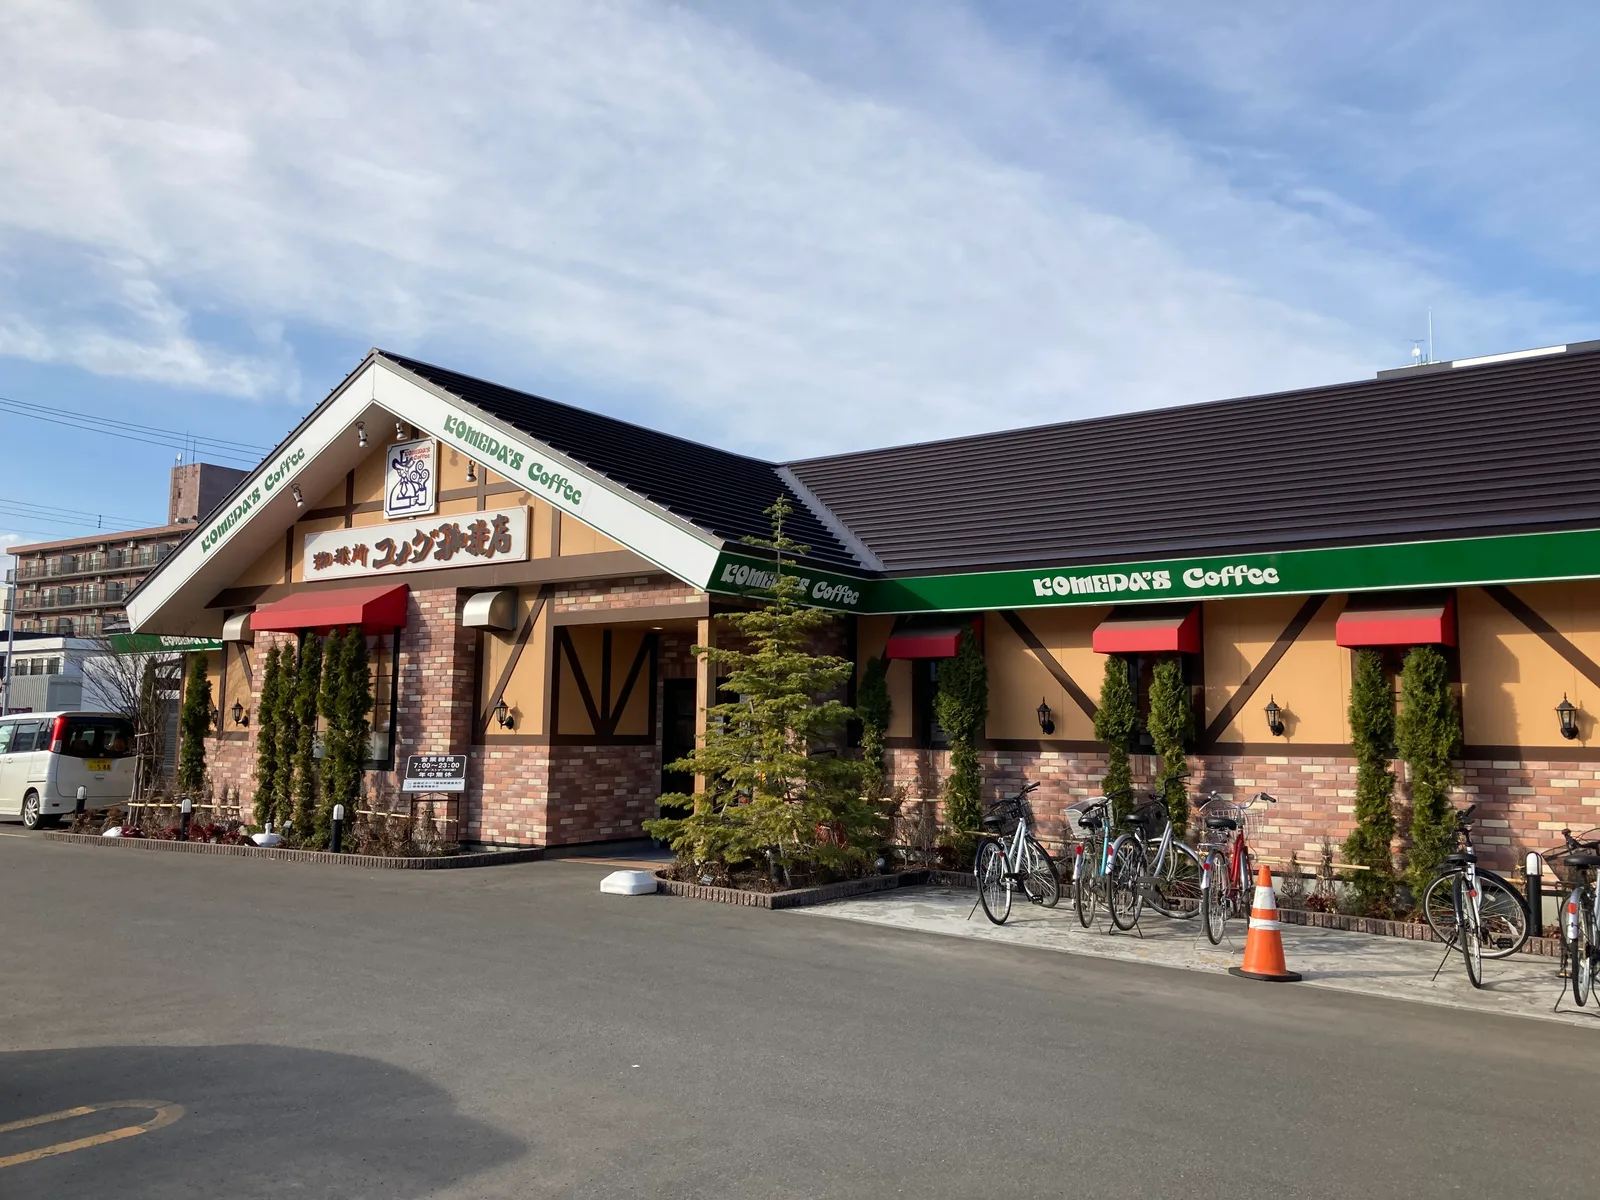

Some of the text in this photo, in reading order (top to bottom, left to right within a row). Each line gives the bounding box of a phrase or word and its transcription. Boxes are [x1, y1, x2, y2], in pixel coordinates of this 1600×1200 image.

[443, 414, 582, 505] KOMEDA'S Coffee
[201, 447, 306, 554] KOMEDA'S Coffee
[720, 563, 859, 605] KOMES Coffee
[1032, 564, 1280, 597] KOMEDA'S Coffee
